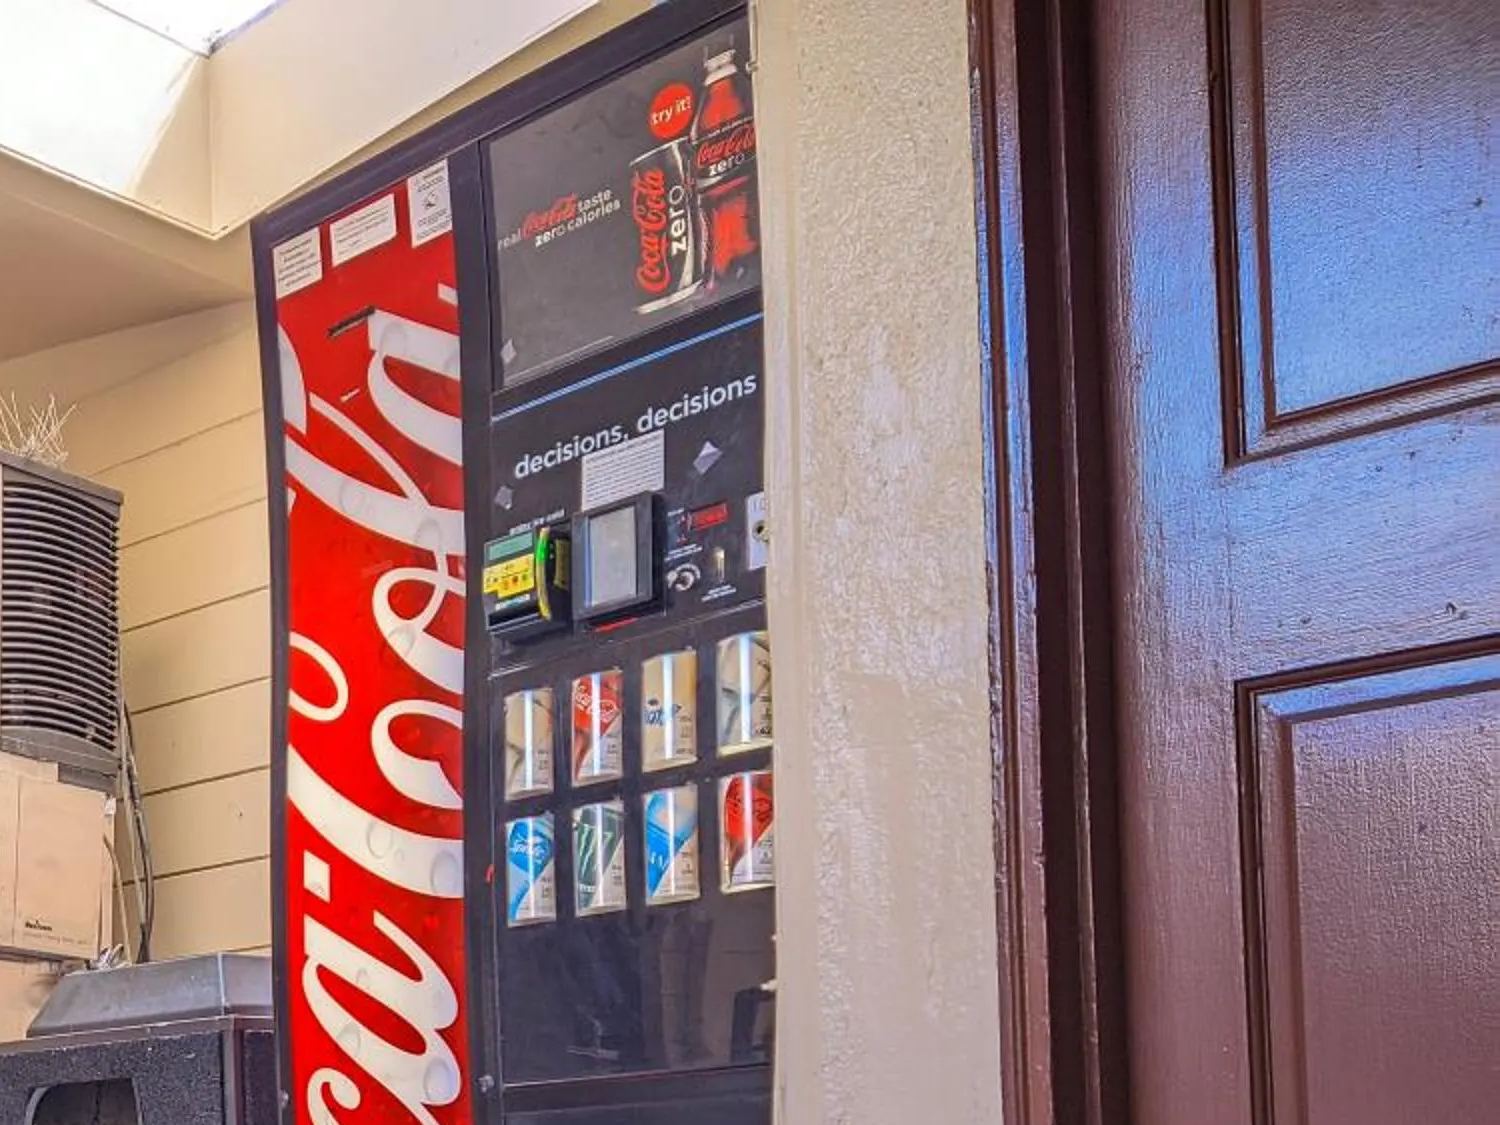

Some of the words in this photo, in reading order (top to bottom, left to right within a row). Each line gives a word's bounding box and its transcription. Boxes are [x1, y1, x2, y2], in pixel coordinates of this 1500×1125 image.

[651, 105, 673, 126] try
[675, 95, 692, 113] it!
[708, 152, 746, 176] zero
[577, 188, 612, 213] taste
[534, 223, 567, 248] zero
[566, 198, 621, 231] calories
[669, 185, 688, 257] zero
[514, 423, 629, 479] decisions,
[636, 373, 757, 432] decisions
